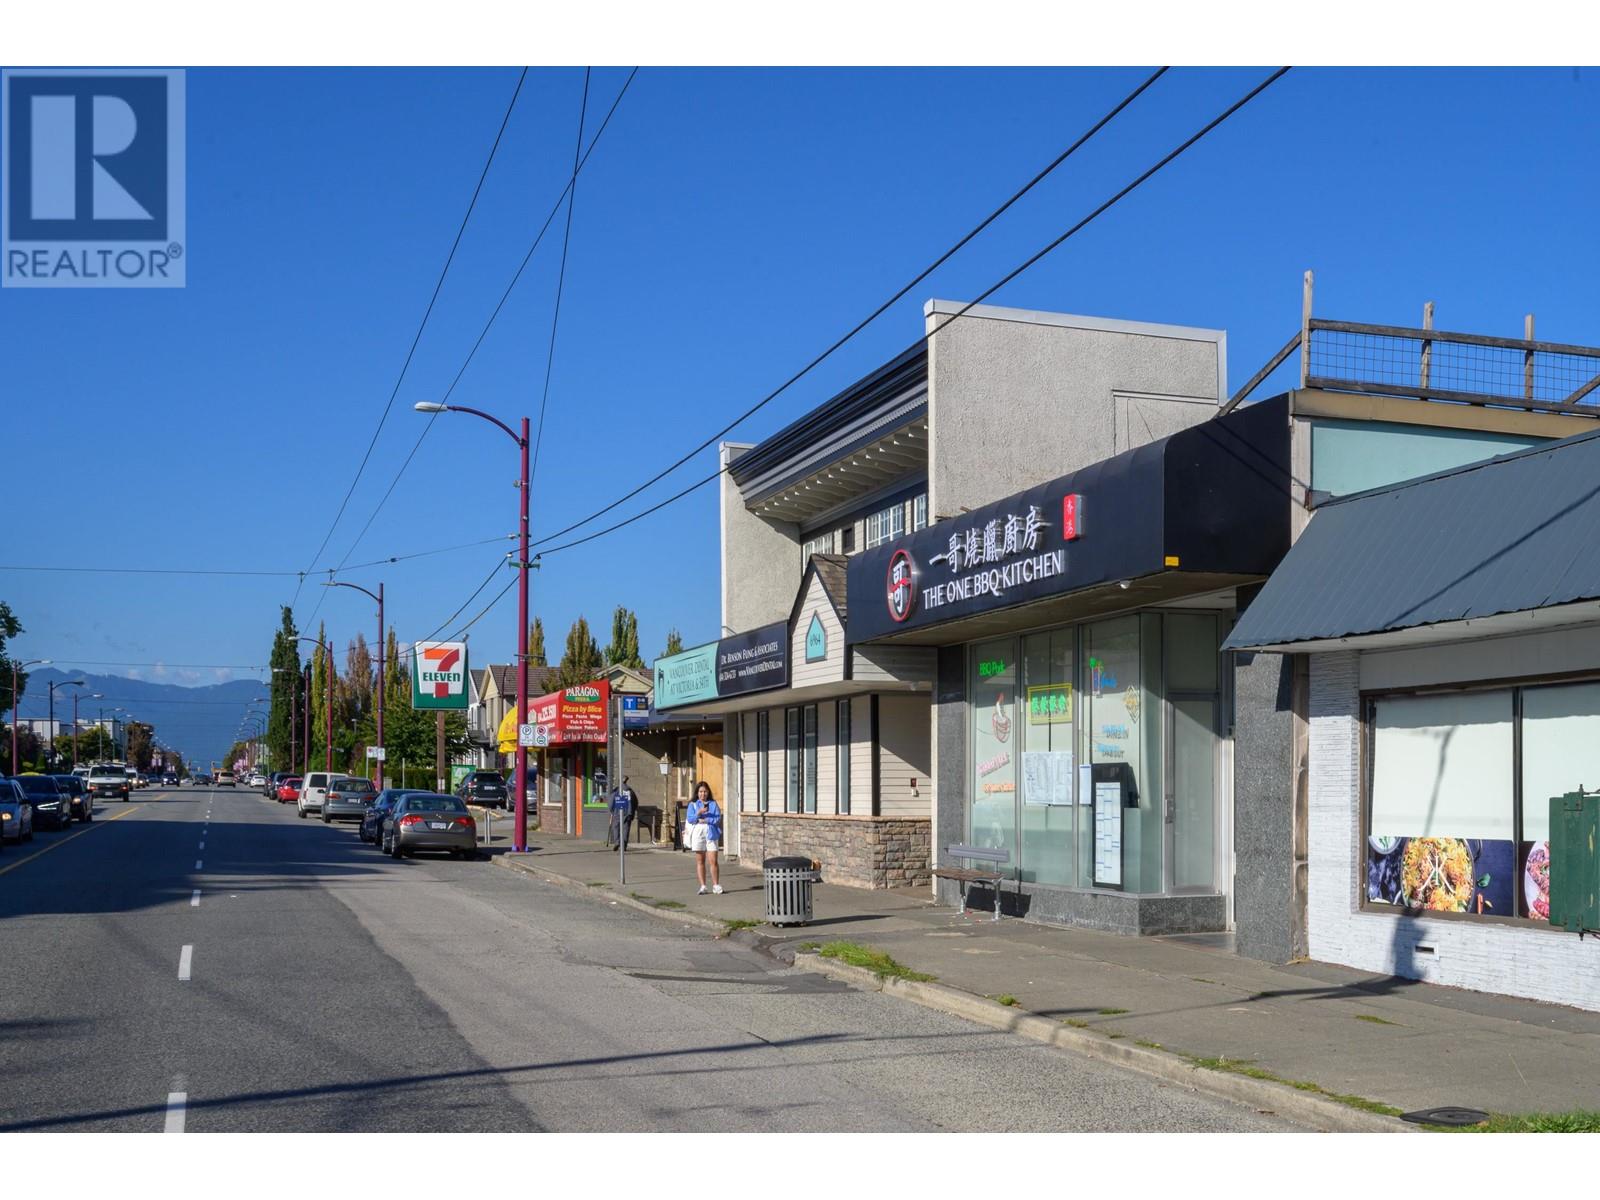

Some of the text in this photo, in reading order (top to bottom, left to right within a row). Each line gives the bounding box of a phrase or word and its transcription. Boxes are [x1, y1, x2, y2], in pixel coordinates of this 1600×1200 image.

[923, 549, 1063, 609] THE ONE BBQ KITCHEN
[424, 648, 460, 698] 7
[566, 686, 600, 697] PARAGON
[562, 705, 579, 713] Pizza
[580, 705, 587, 714] by
